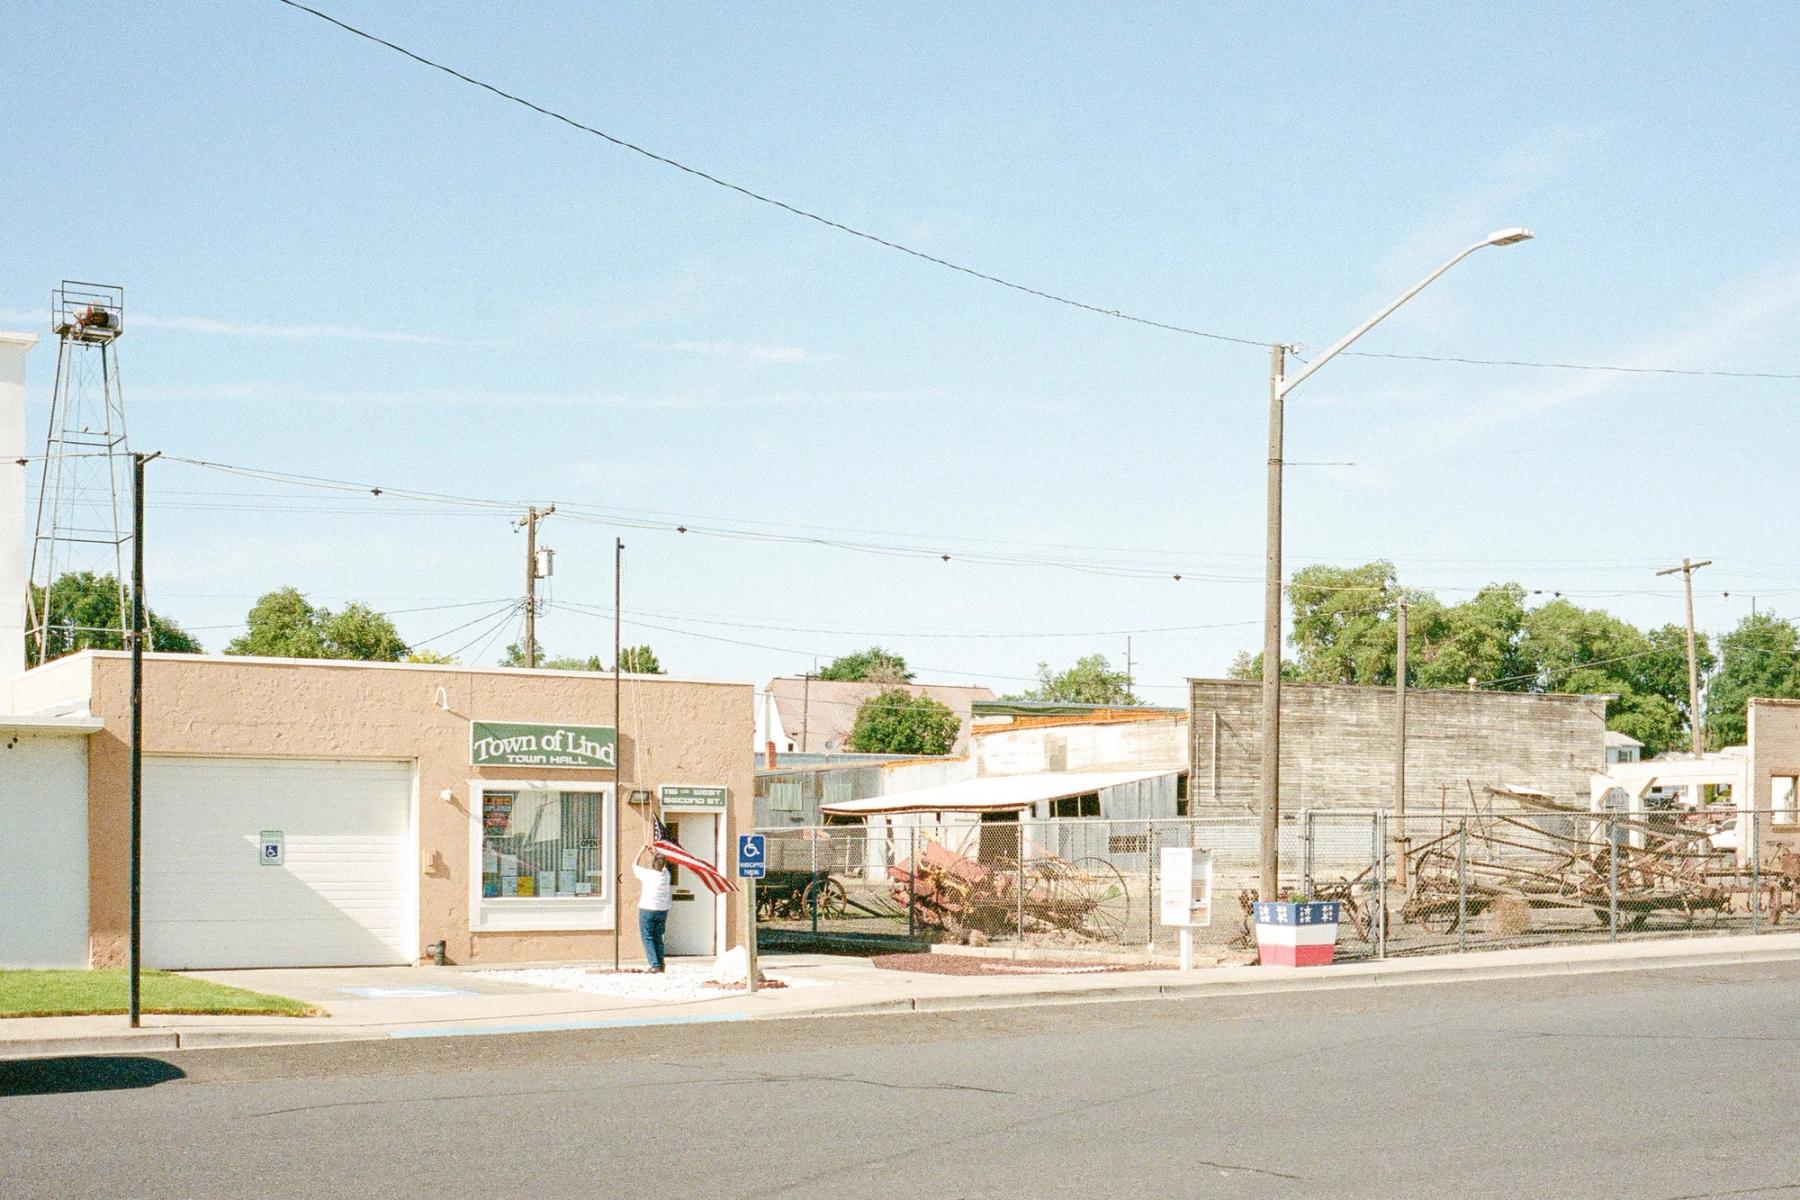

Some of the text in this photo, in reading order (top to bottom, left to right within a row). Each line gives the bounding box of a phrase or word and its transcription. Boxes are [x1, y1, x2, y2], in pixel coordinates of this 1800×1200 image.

[474, 730, 616, 766] Town of Lind
[507, 754, 588, 764] TOWN HALL
